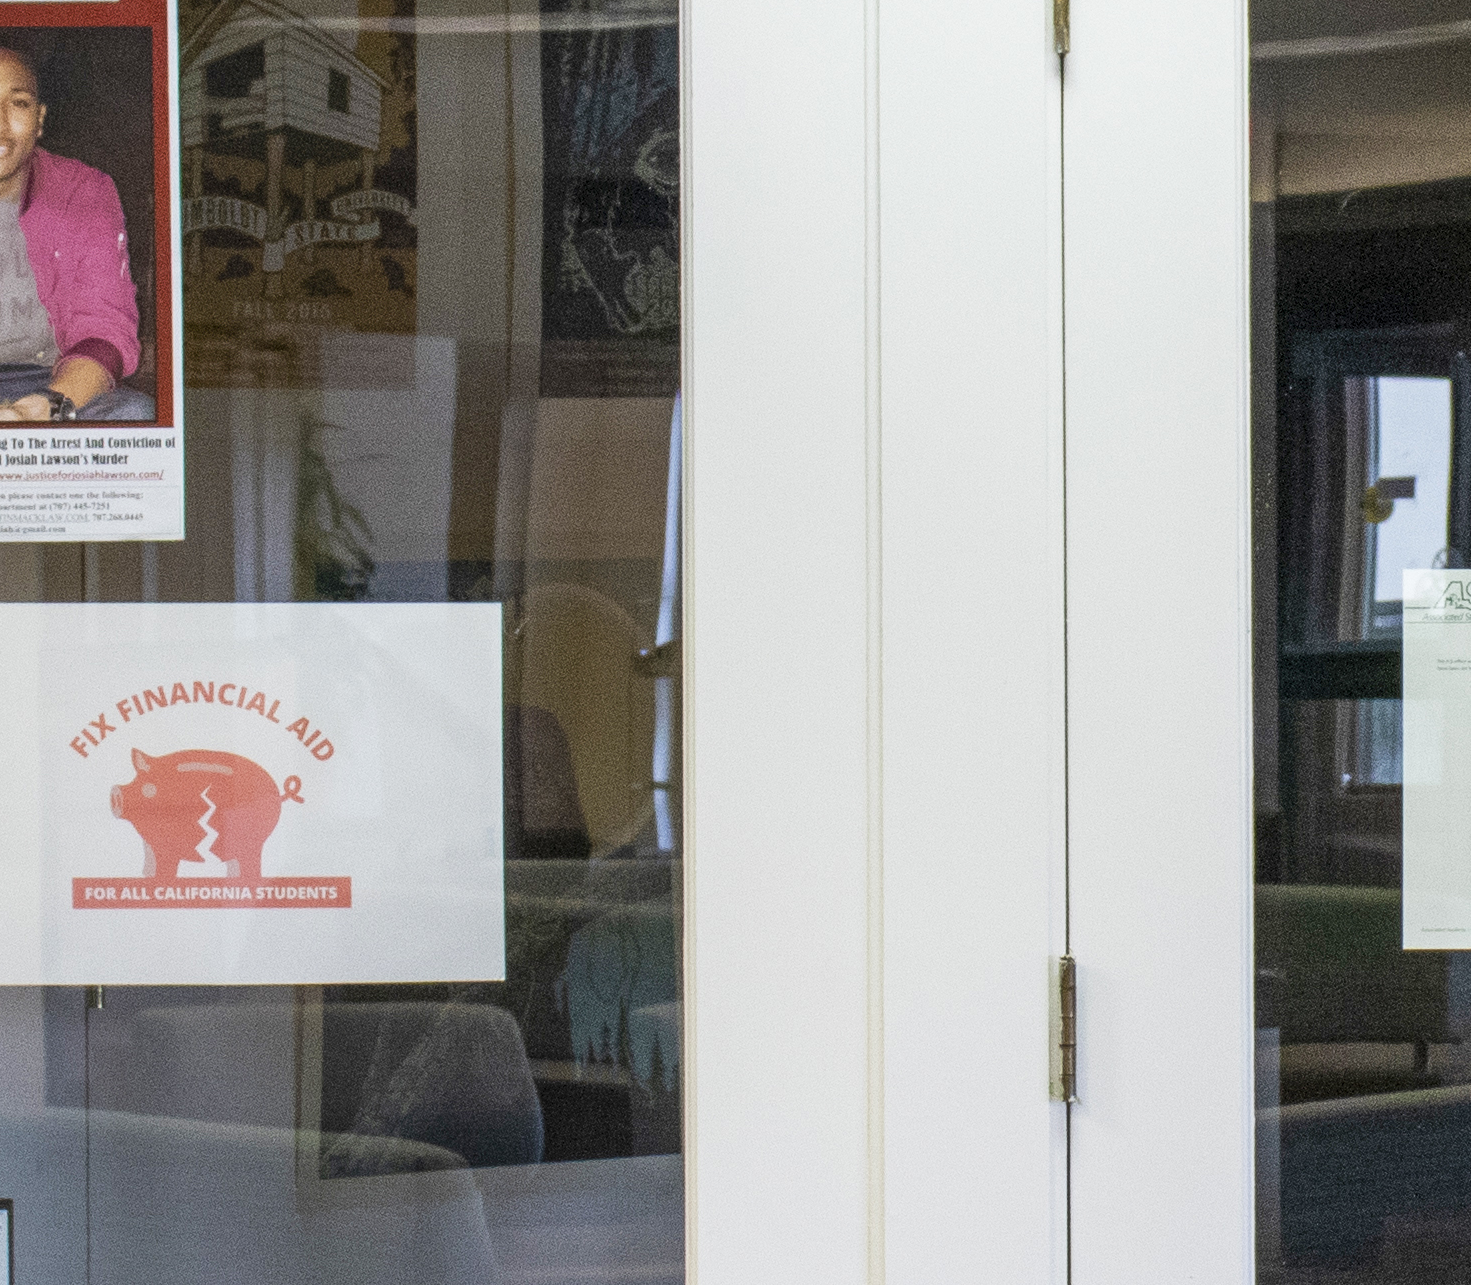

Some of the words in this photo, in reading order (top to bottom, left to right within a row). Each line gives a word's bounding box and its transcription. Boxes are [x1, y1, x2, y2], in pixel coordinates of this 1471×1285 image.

[6, 454, 37, 465] Josiah
[91, 453, 129, 465] Murder
[69, 712, 117, 759] FIX
[116, 681, 281, 724] FINANCIAL
[286, 716, 335, 763] AID
[85, 887, 116, 900] FOR
[121, 887, 150, 900] ALL
[154, 886, 251, 900] CALIFORNIA
[256, 886, 338, 900] STUDENTS
